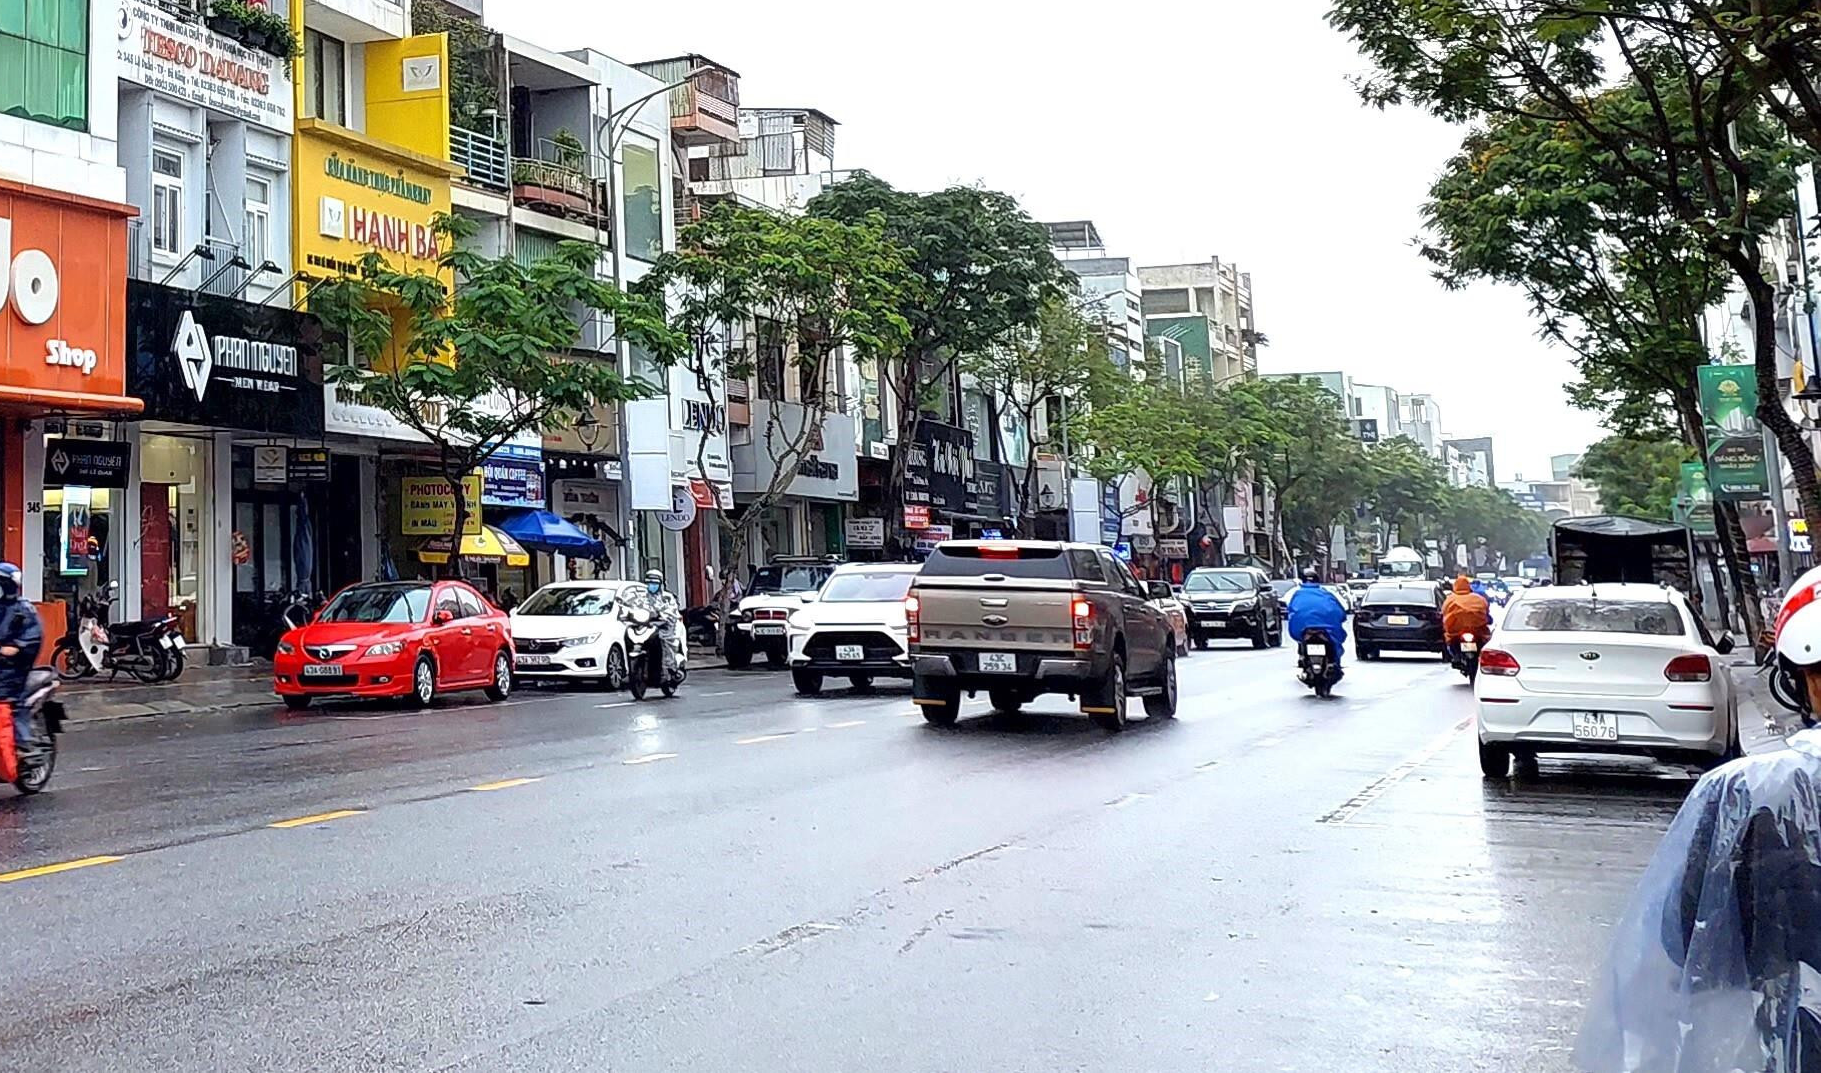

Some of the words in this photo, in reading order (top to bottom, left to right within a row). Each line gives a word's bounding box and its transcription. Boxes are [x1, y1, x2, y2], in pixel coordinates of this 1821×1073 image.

[45, 338, 98, 376] Shop
[234, 376, 254, 390] MEN
[26, 502, 41, 514] 345
[661, 512, 691, 523] LENDO
[923, 629, 1071, 643] RANGER
